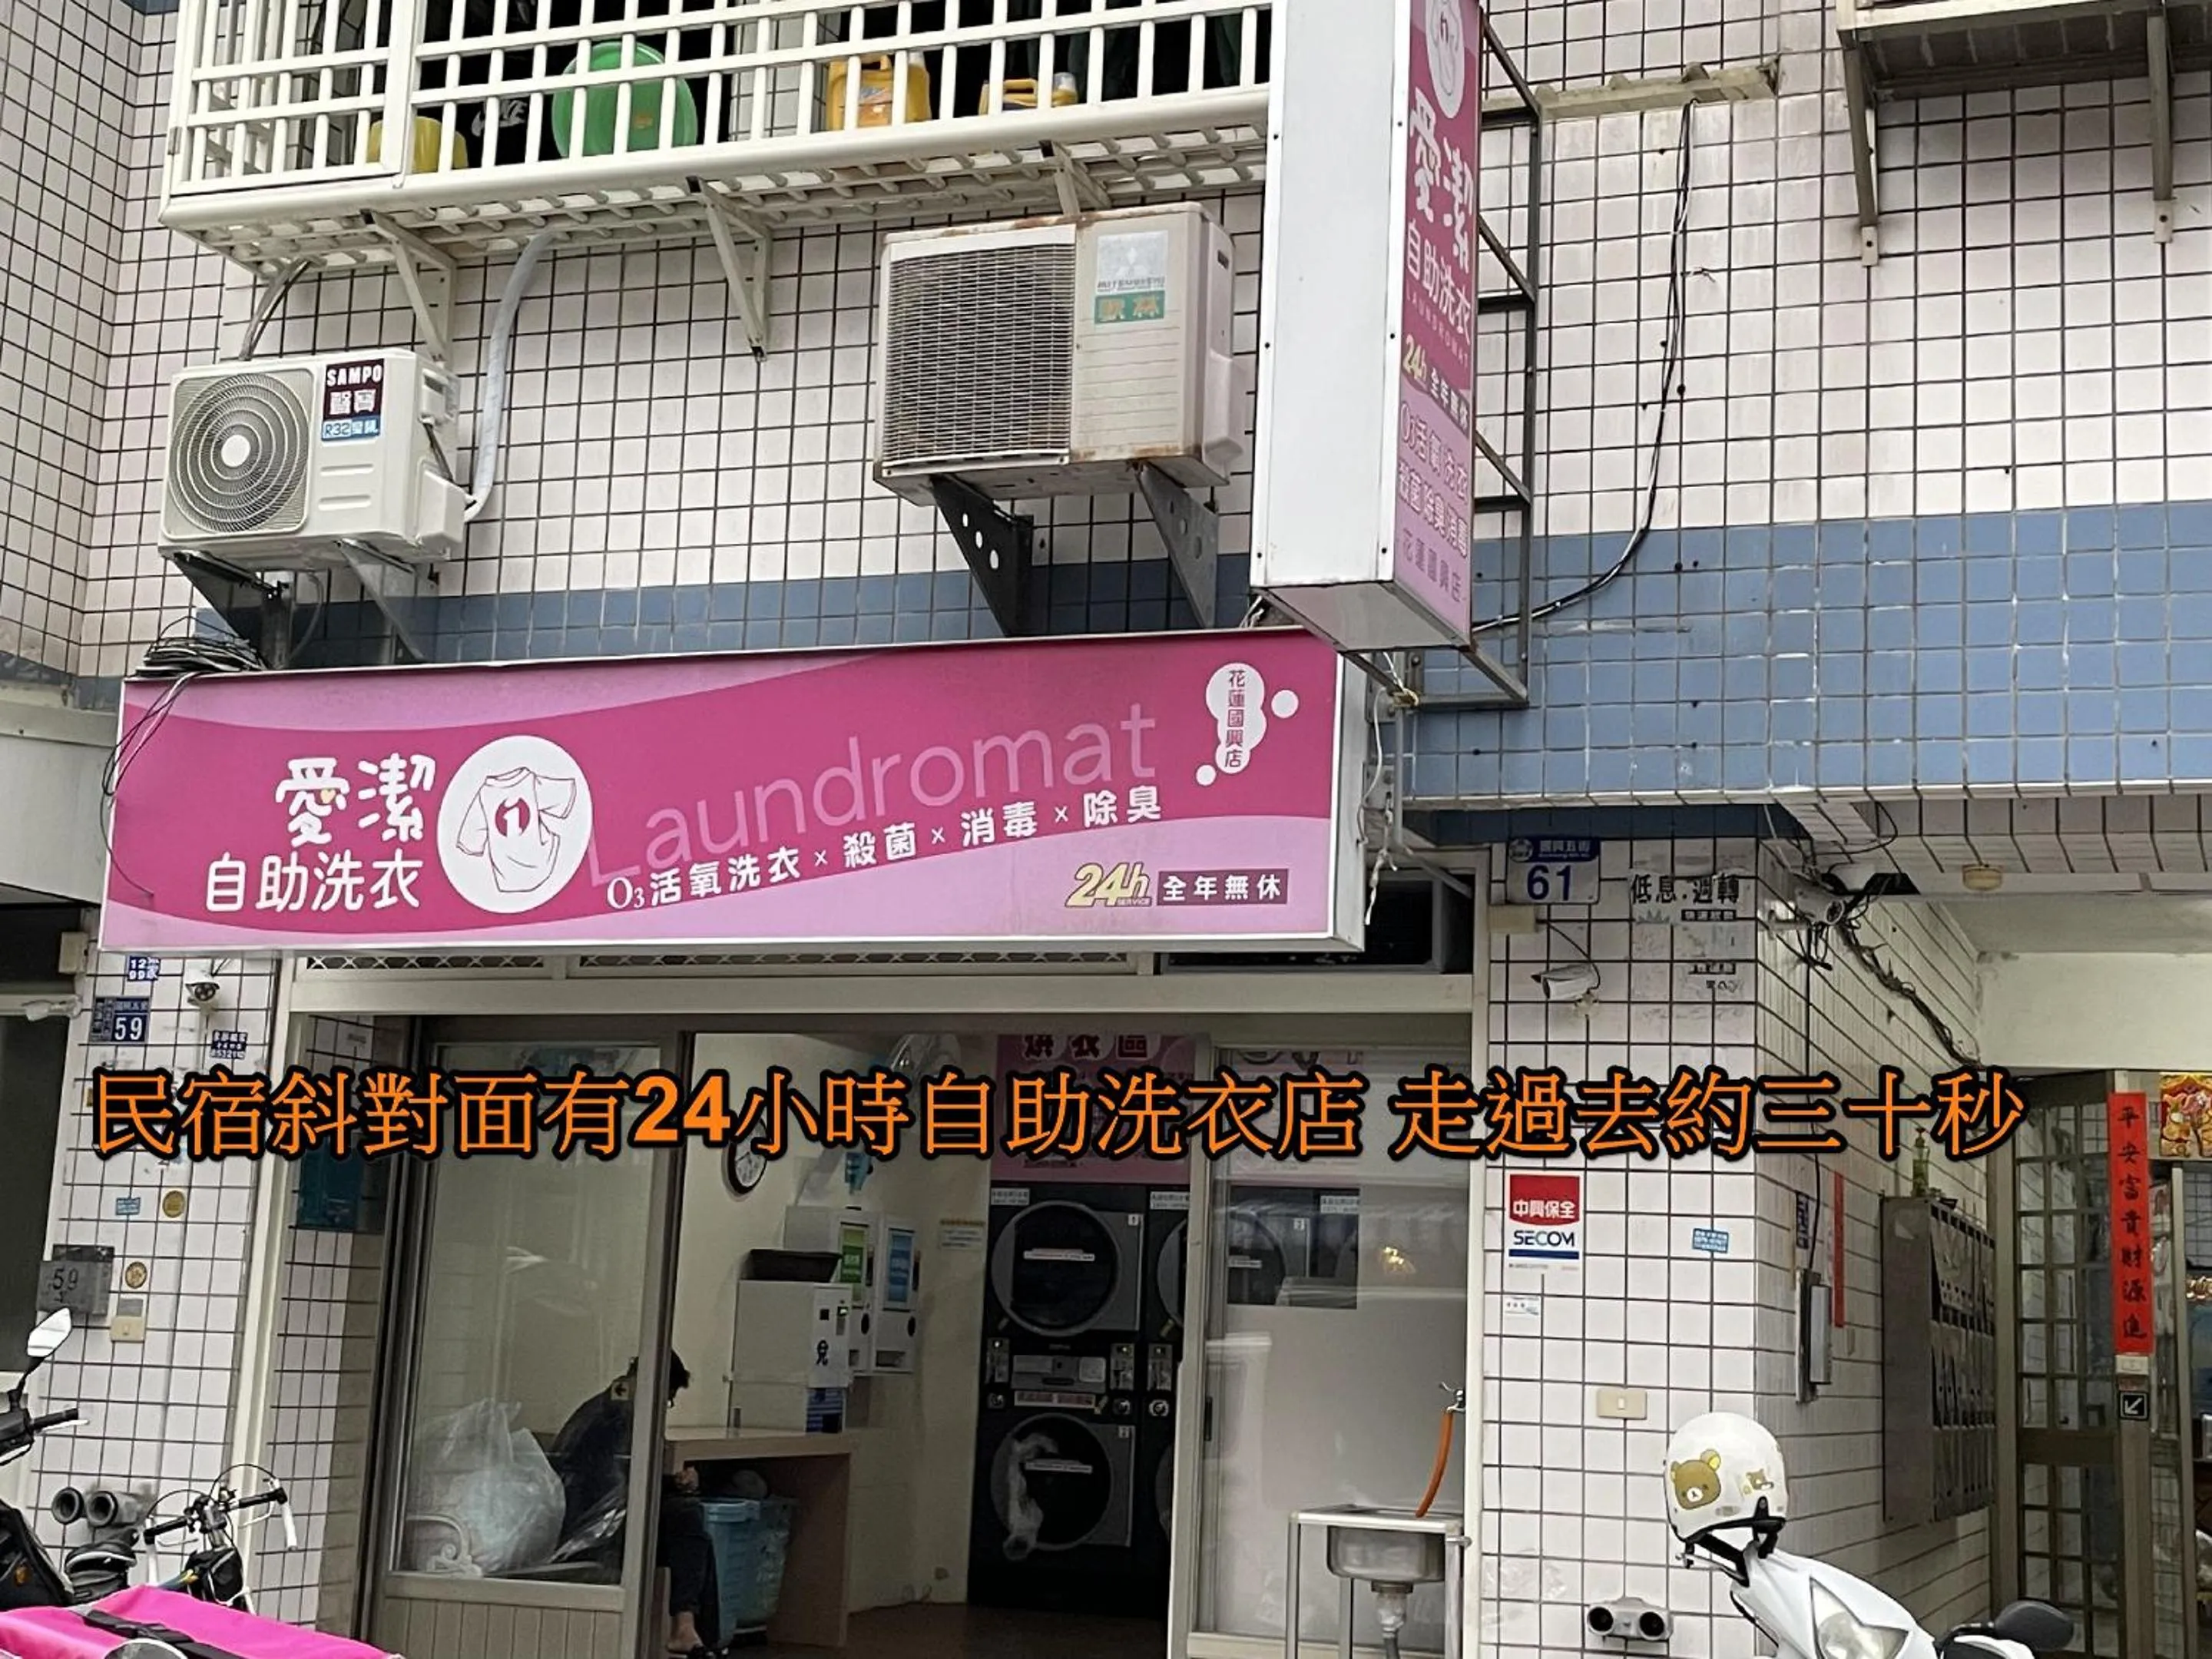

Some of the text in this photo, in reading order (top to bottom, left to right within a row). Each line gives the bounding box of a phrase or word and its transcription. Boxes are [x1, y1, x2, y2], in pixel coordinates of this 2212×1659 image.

[1406, 218, 1472, 345] 自助洗衣
[326, 365, 382, 386] SAMPO
[1225, 669, 1246, 767] 花蓮國興店
[275, 752, 436, 846] 愛潔
[588, 704, 1157, 883] Laundromat
[205, 850, 424, 912] 自助洗衣
[1065, 861, 1282, 907] 24h 全年無休
[1527, 865, 1571, 902] 61
[114, 1017, 143, 1041] 59
[1513, 1200, 1575, 1219] 中興保全
[1513, 1230, 1575, 1247] SECOM
